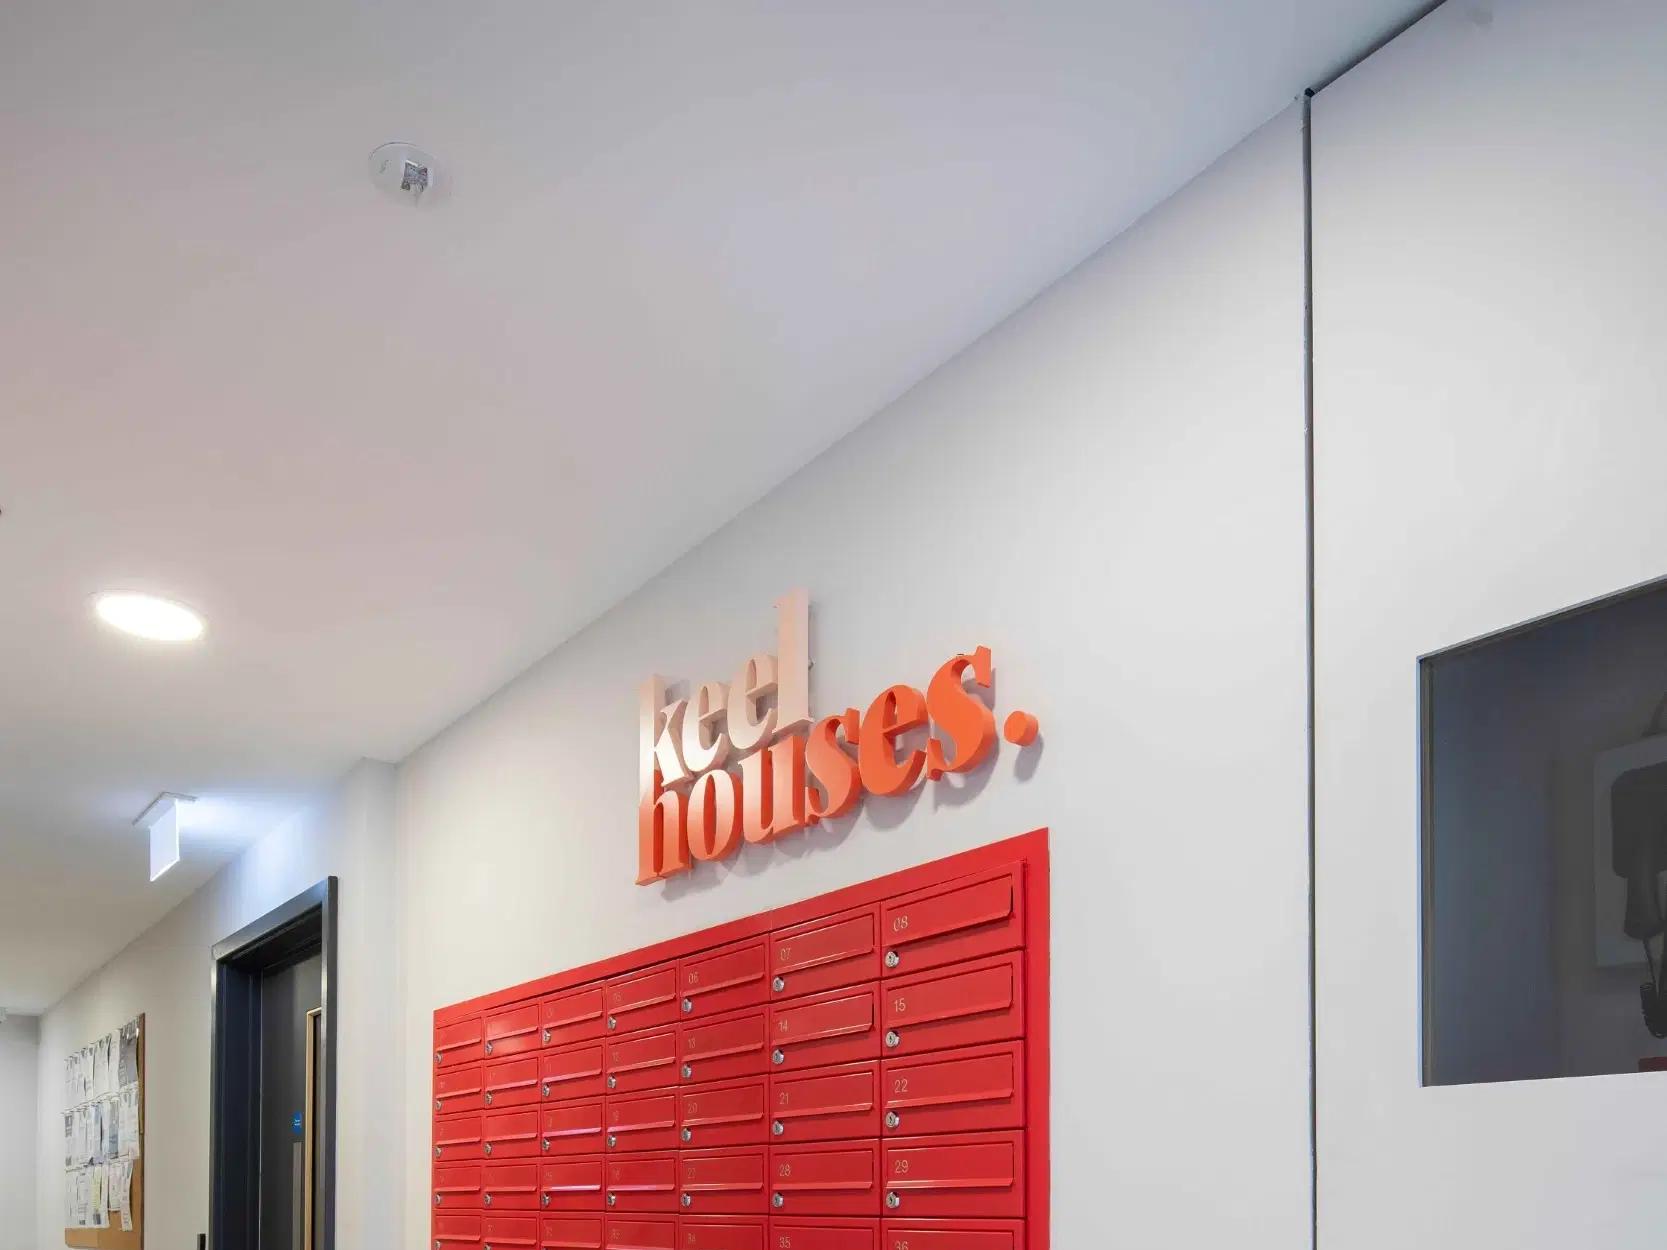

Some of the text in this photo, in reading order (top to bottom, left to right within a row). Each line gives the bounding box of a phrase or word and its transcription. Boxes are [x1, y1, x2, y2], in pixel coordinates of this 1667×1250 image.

[638, 587, 814, 788] keel
[635, 645, 1039, 886] houses.
[893, 915, 909, 931] 08
[780, 947, 792, 961] 07
[894, 997, 906, 1012] 15
[778, 1019, 790, 1032] 14
[894, 1078, 908, 1093] 22
[779, 1091, 789, 1105] 21
[687, 1101, 698, 1115] 20
[779, 1163, 791, 1177] 28
[894, 1159, 909, 1173] 29
[779, 1235, 791, 1249] 35
